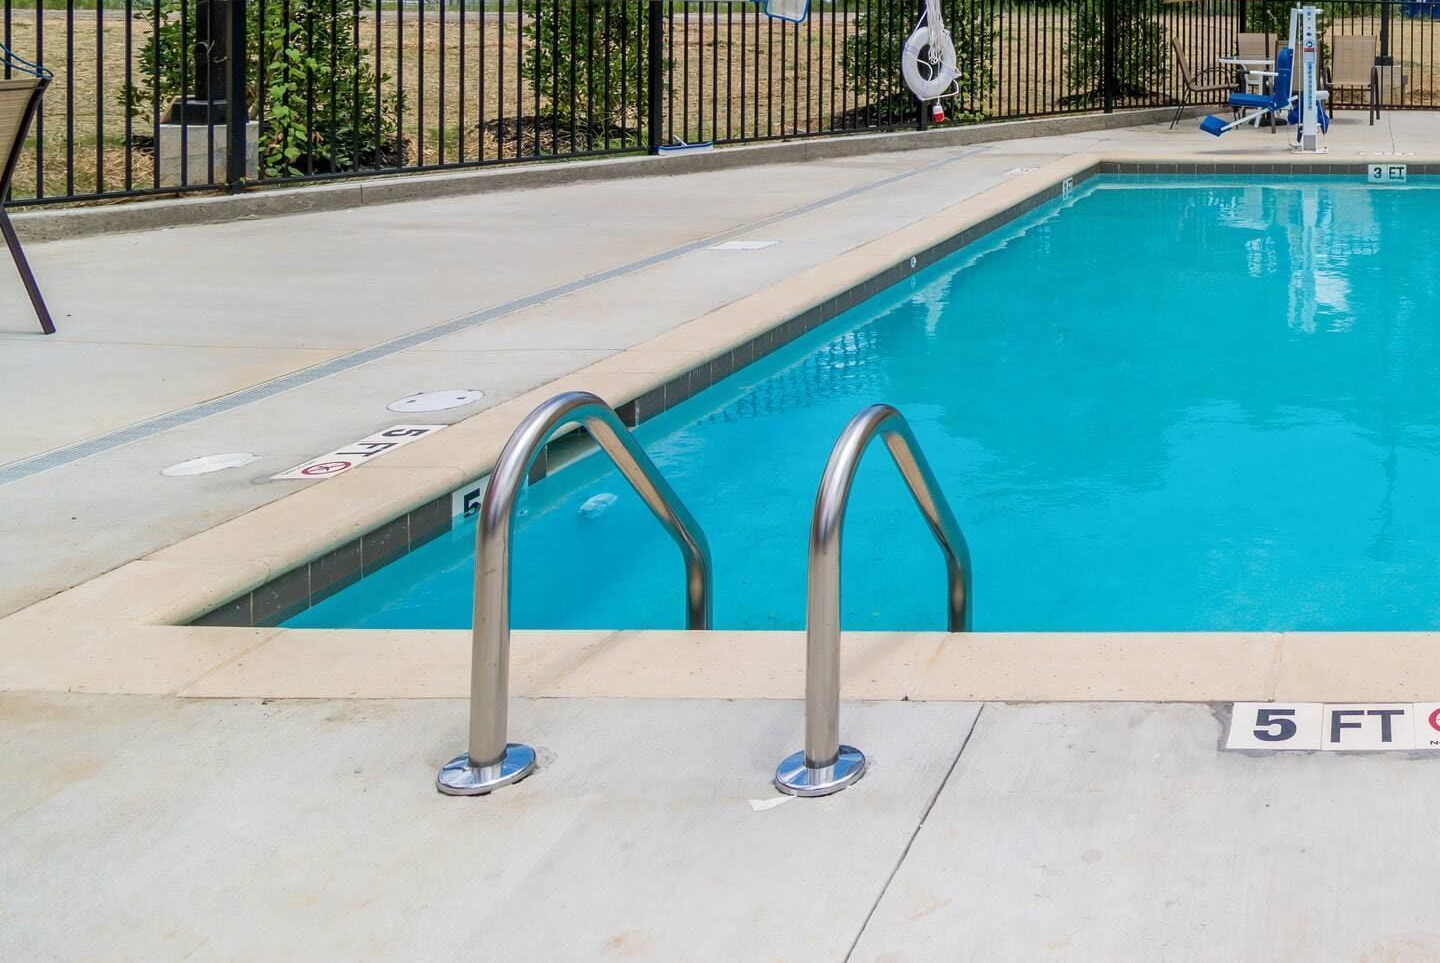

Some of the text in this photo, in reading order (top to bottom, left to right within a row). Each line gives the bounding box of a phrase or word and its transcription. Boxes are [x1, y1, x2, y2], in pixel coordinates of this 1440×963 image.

[1374, 167, 1382, 179] 3
[336, 428, 428, 458] 5 FT
[463, 487, 481, 519] 5
[1253, 708, 1405, 743] 5 FT
